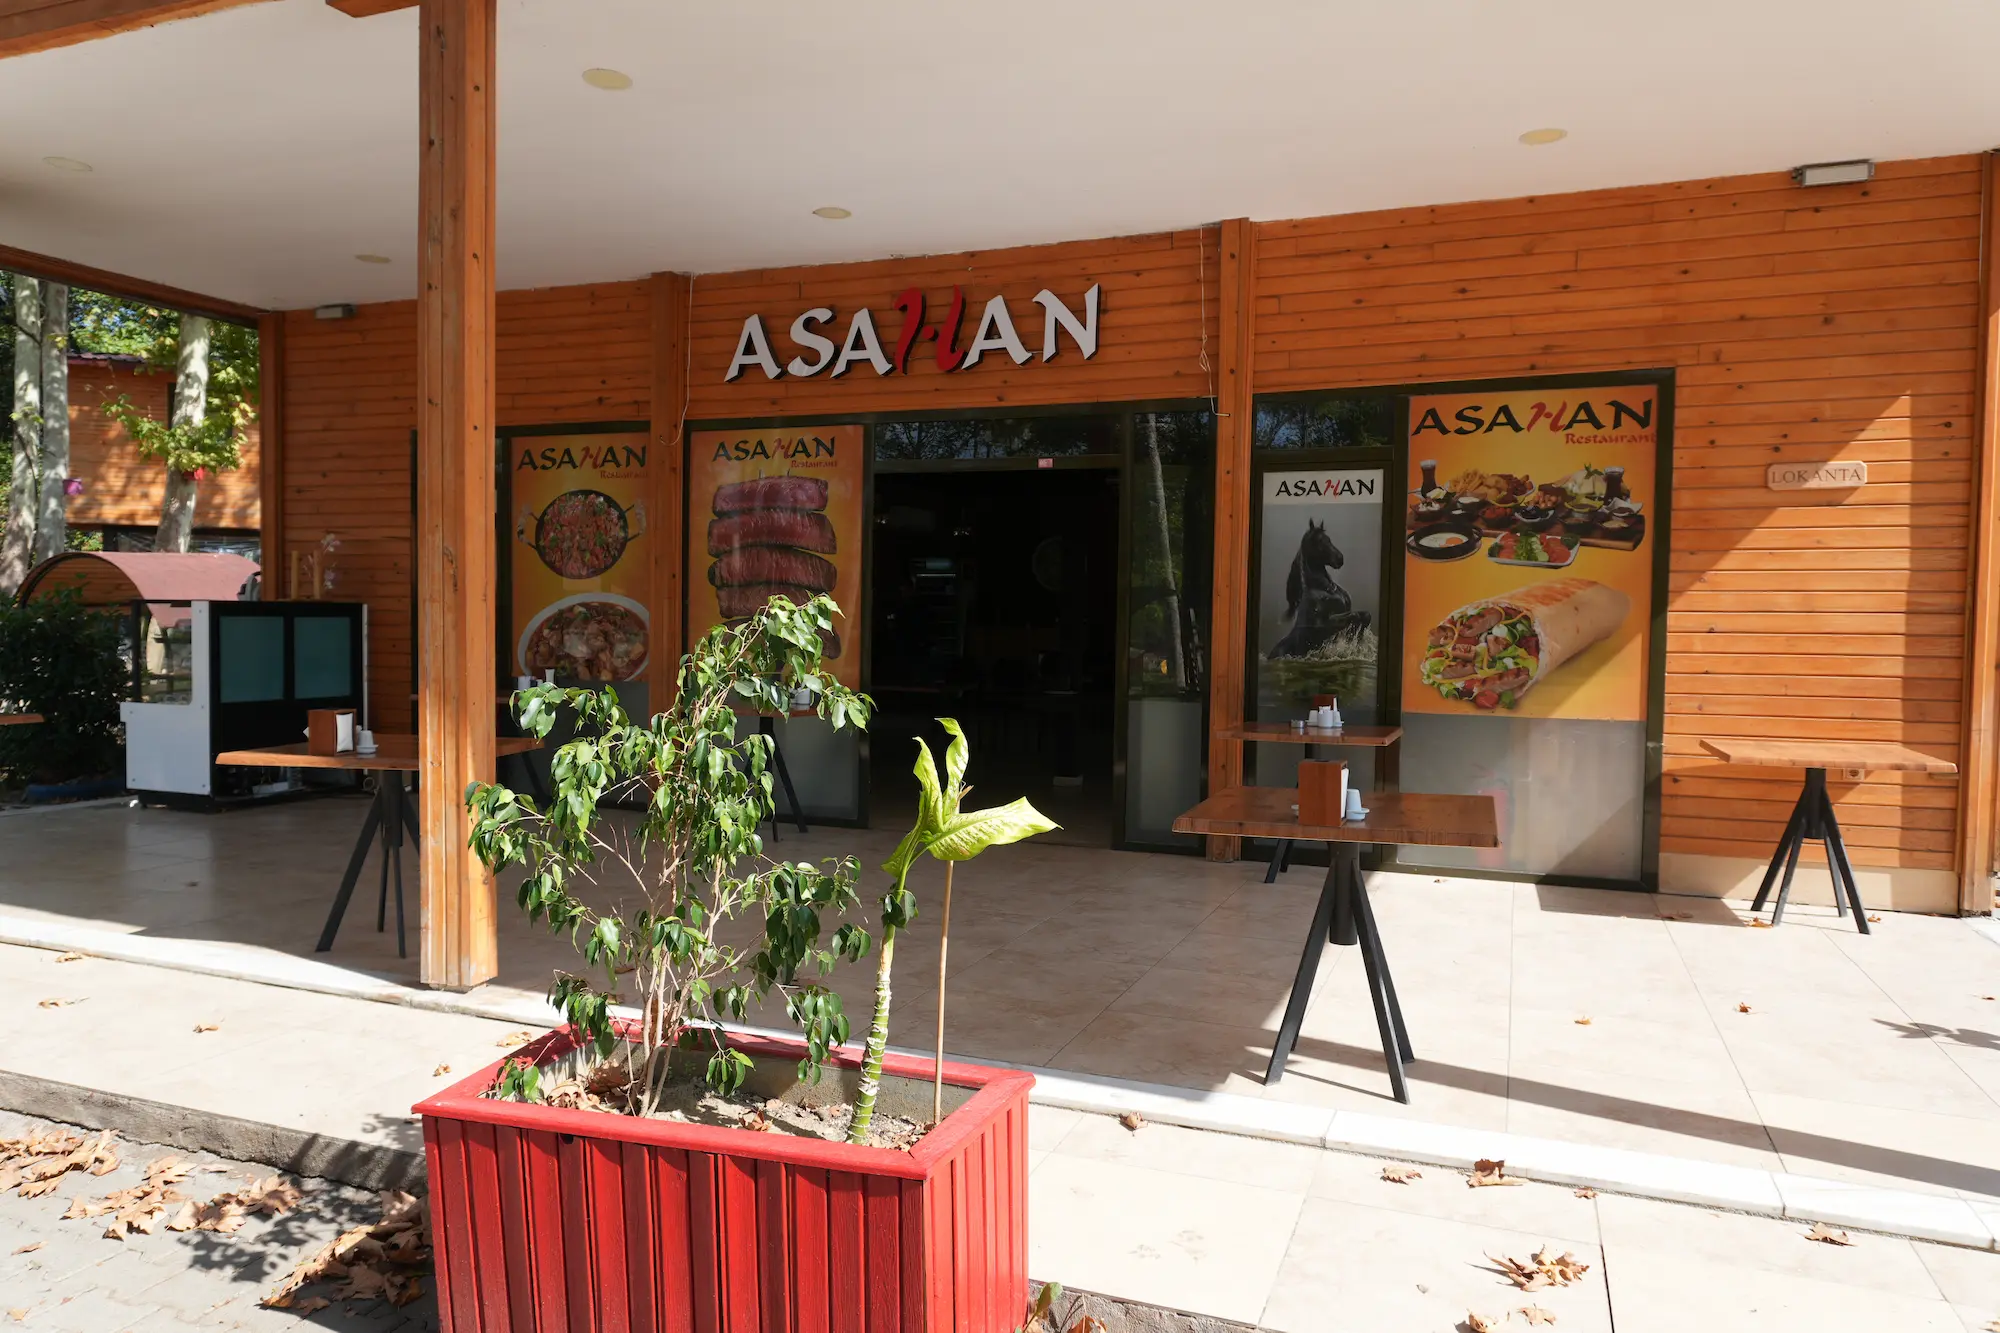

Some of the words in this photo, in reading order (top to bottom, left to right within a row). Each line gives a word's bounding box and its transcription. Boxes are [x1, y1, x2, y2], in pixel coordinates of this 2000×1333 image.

[724, 283, 1101, 383] ASAHAN
[1412, 398, 1653, 436] ASAHAN
[712, 436, 835, 462] ASAHAN
[1564, 431, 1657, 444] Restaurant
[517, 443, 647, 471] ASAHAN
[1275, 478, 1375, 498] ASAHAN
[1771, 468, 1861, 484] LOKANTA
